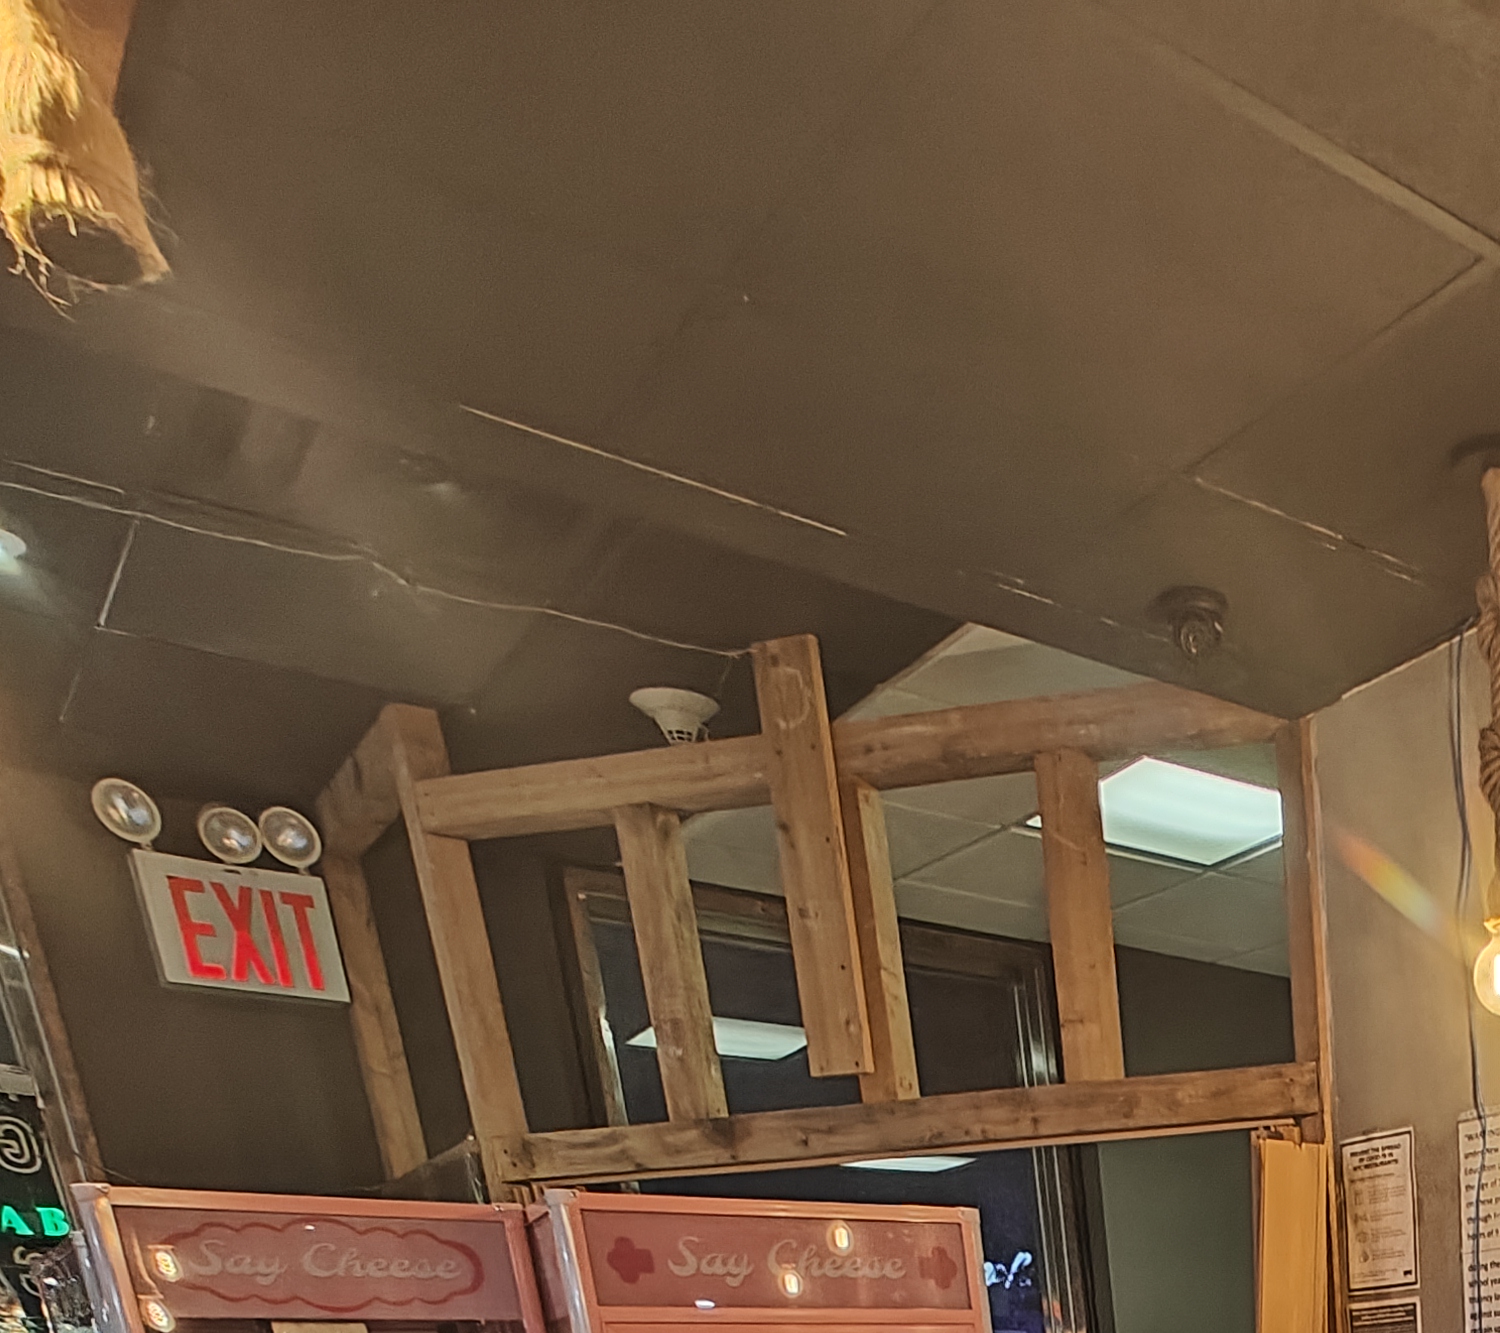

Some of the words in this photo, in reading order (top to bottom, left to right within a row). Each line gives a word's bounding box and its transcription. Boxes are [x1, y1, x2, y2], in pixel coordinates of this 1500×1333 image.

[166, 875, 326, 991] EXIT
[189, 1239, 287, 1286] Say
[301, 1242, 462, 1280] Cheese
[667, 1236, 753, 1288] Say
[767, 1239, 907, 1281] Cheese
[1490, 1260, 1500, 1268] the
